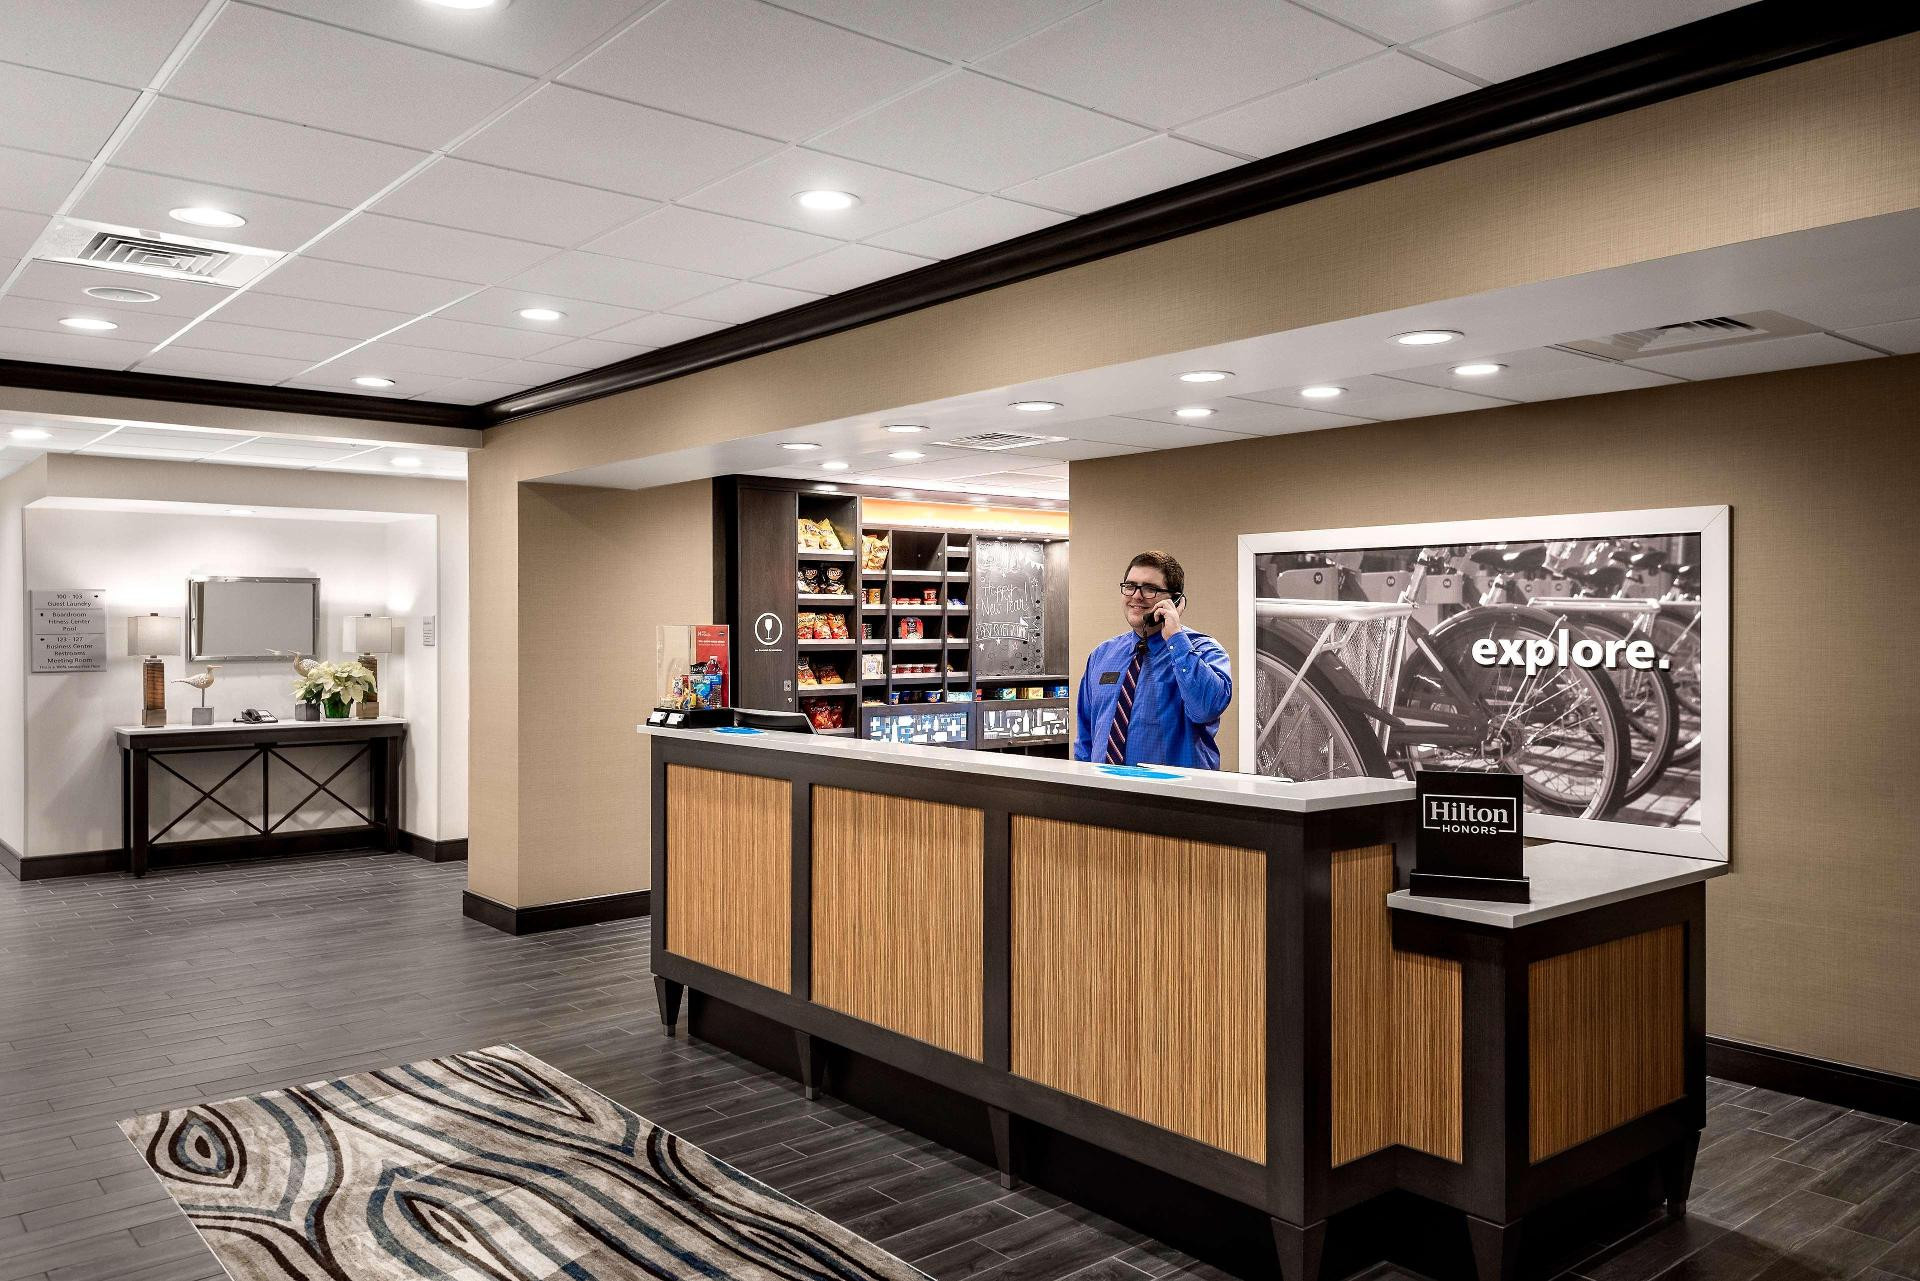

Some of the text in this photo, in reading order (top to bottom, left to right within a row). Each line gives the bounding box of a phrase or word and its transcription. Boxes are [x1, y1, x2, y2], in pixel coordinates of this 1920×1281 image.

[1471, 628, 1671, 677] explore.
[1430, 801, 1509, 824] Hilton
[1442, 824, 1498, 835] HONORS
